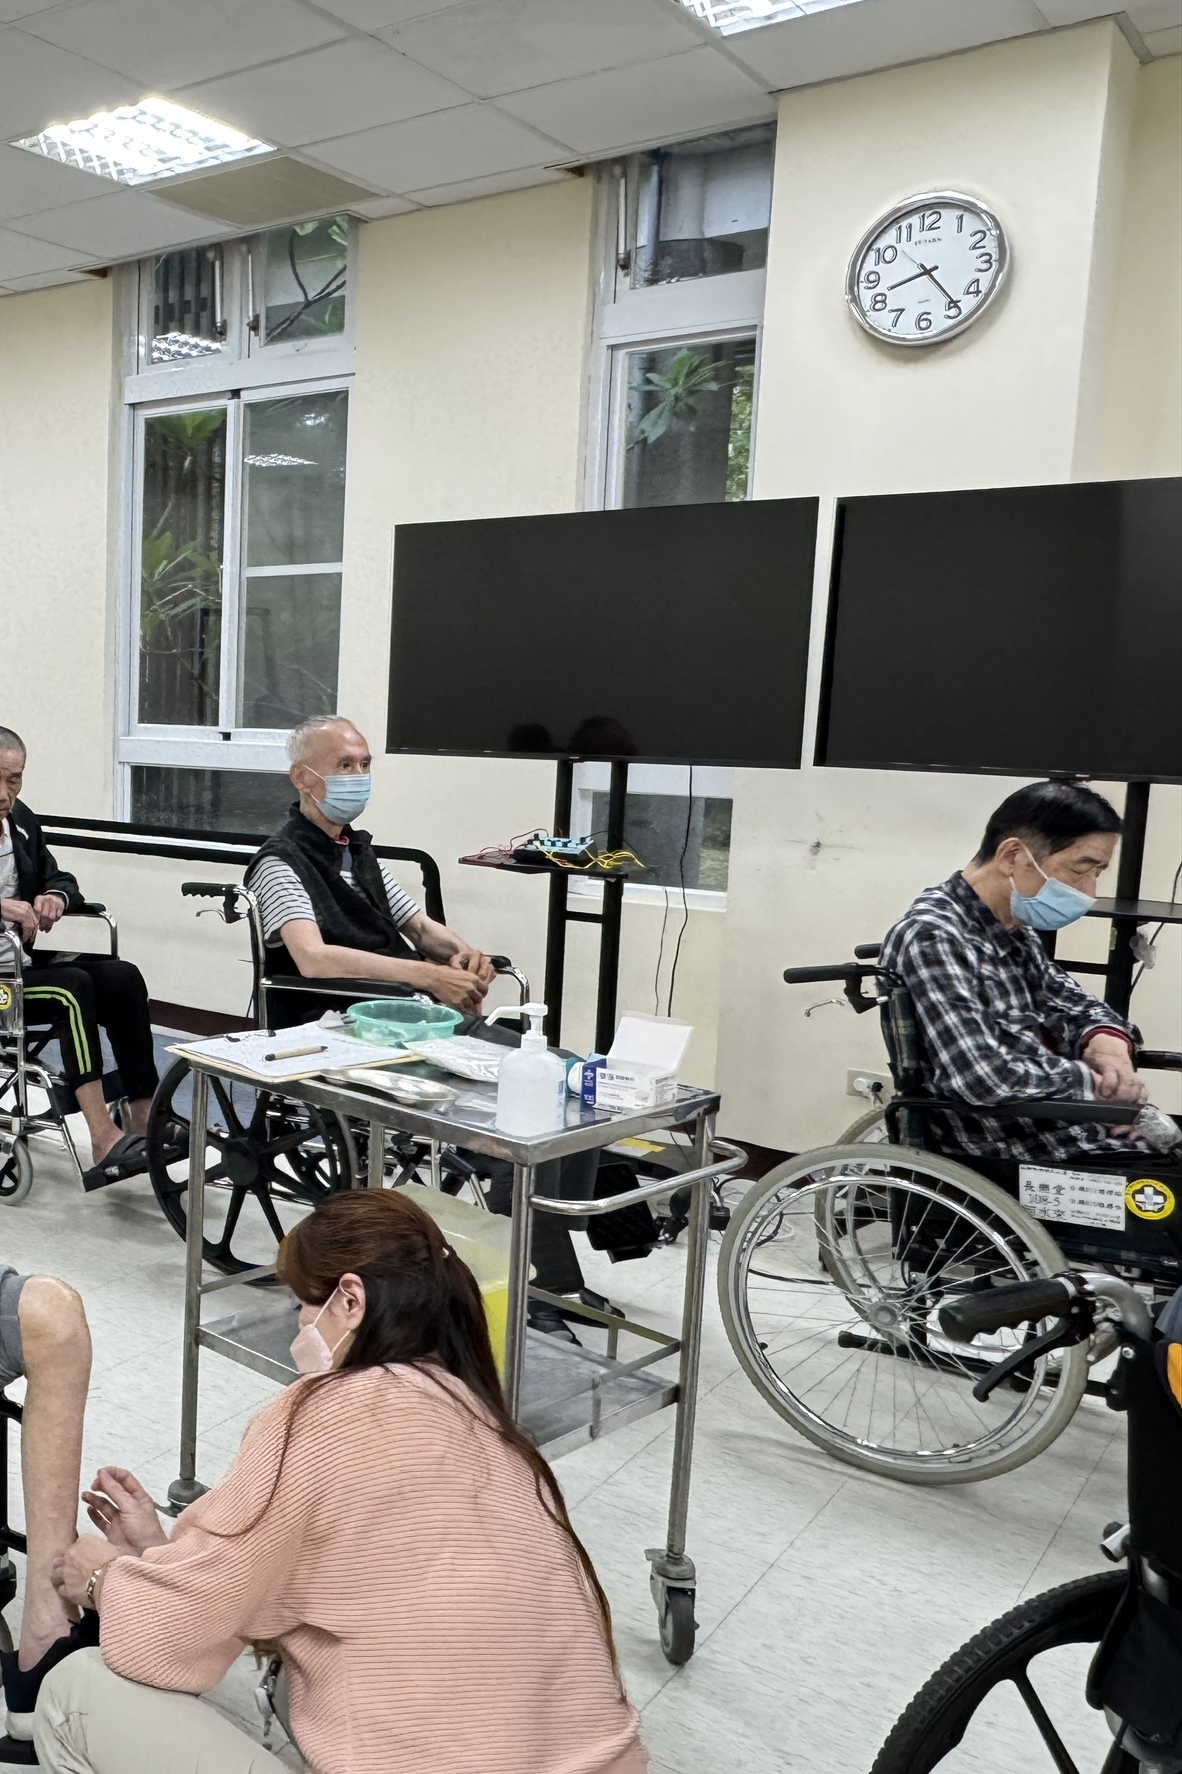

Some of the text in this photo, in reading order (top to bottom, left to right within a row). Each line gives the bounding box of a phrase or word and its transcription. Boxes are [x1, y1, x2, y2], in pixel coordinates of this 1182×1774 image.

[918, 210, 942, 232] 12
[956, 213, 964, 233] 1
[895, 222, 913, 244] 11
[969, 230, 987, 251] 2
[874, 245, 898, 266] 10
[975, 252, 993, 273] 3
[863, 270, 880, 290] 9
[963, 277, 982, 298] 4
[869, 292, 887, 312] 8
[944, 299, 963, 320] 5
[888, 308, 905, 327] 7
[915, 311, 932, 331] 6
